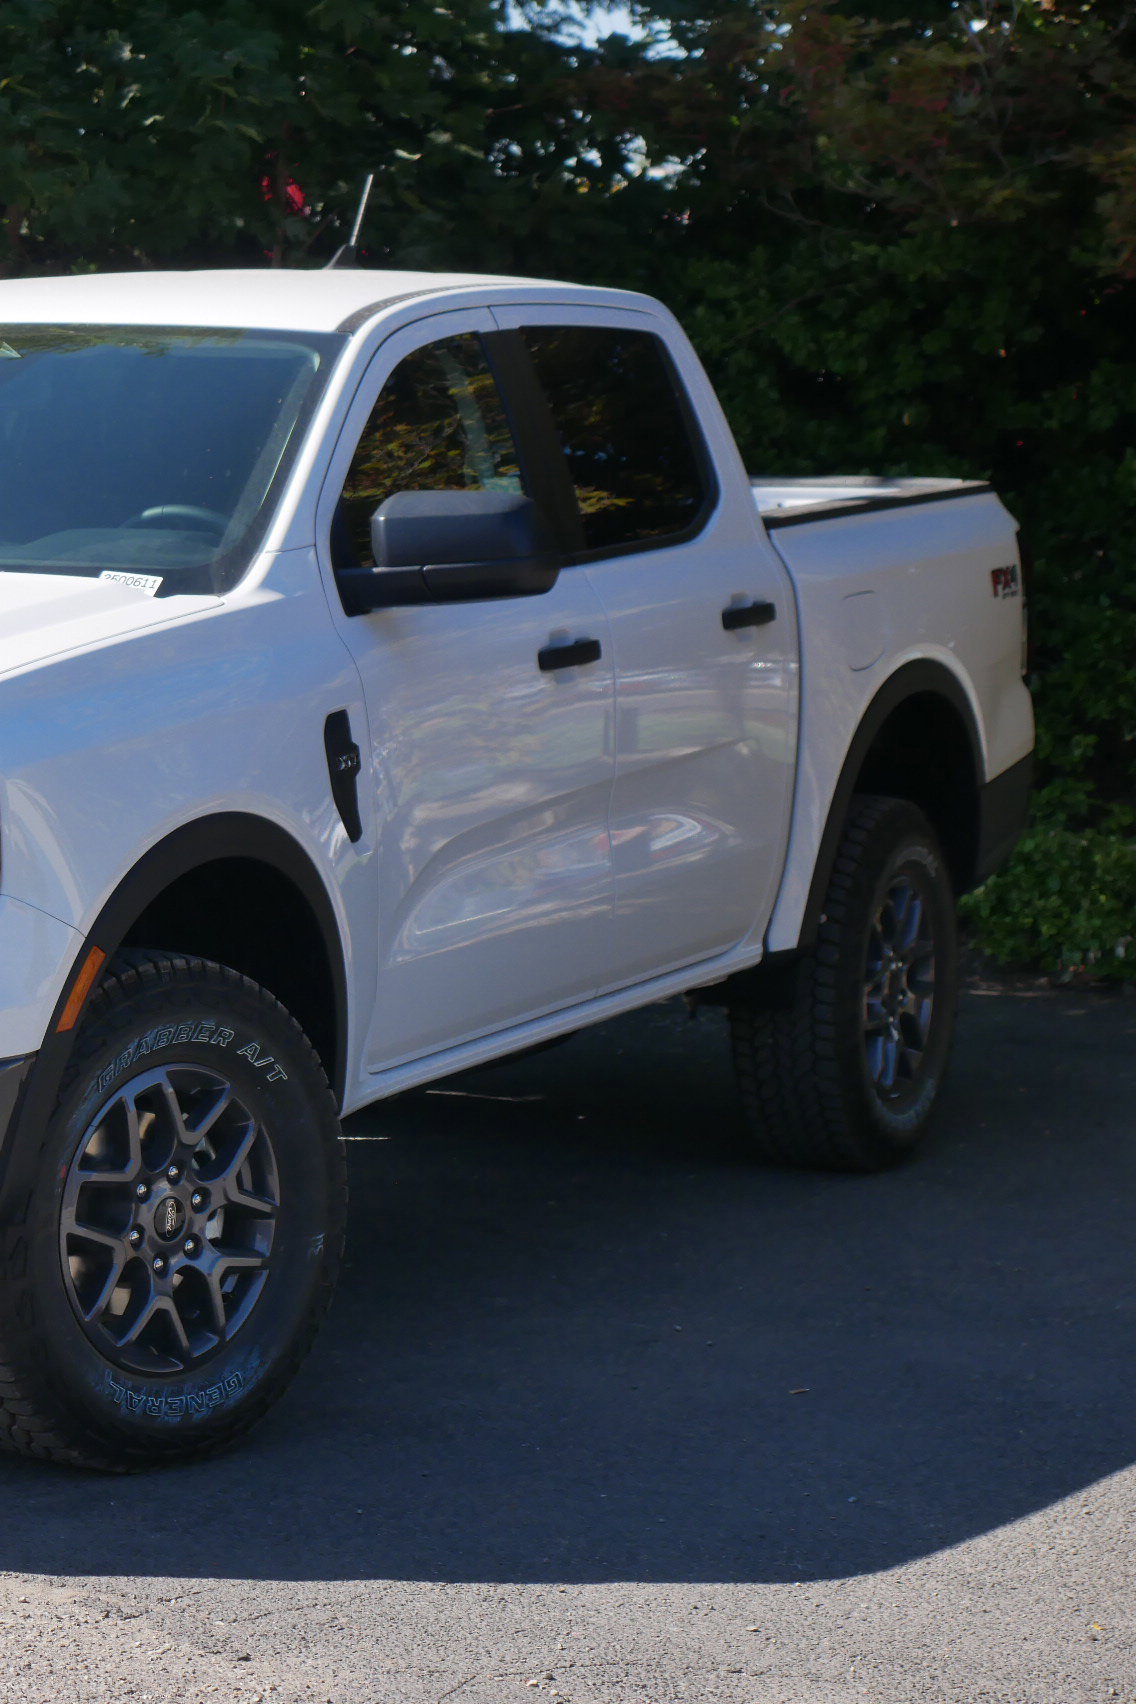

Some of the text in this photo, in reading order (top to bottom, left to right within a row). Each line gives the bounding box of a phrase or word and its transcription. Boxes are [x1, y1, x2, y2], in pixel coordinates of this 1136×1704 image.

[95, 1023, 288, 1093] GRABBER A/T
[110, 1371, 244, 1416] GENERAL
